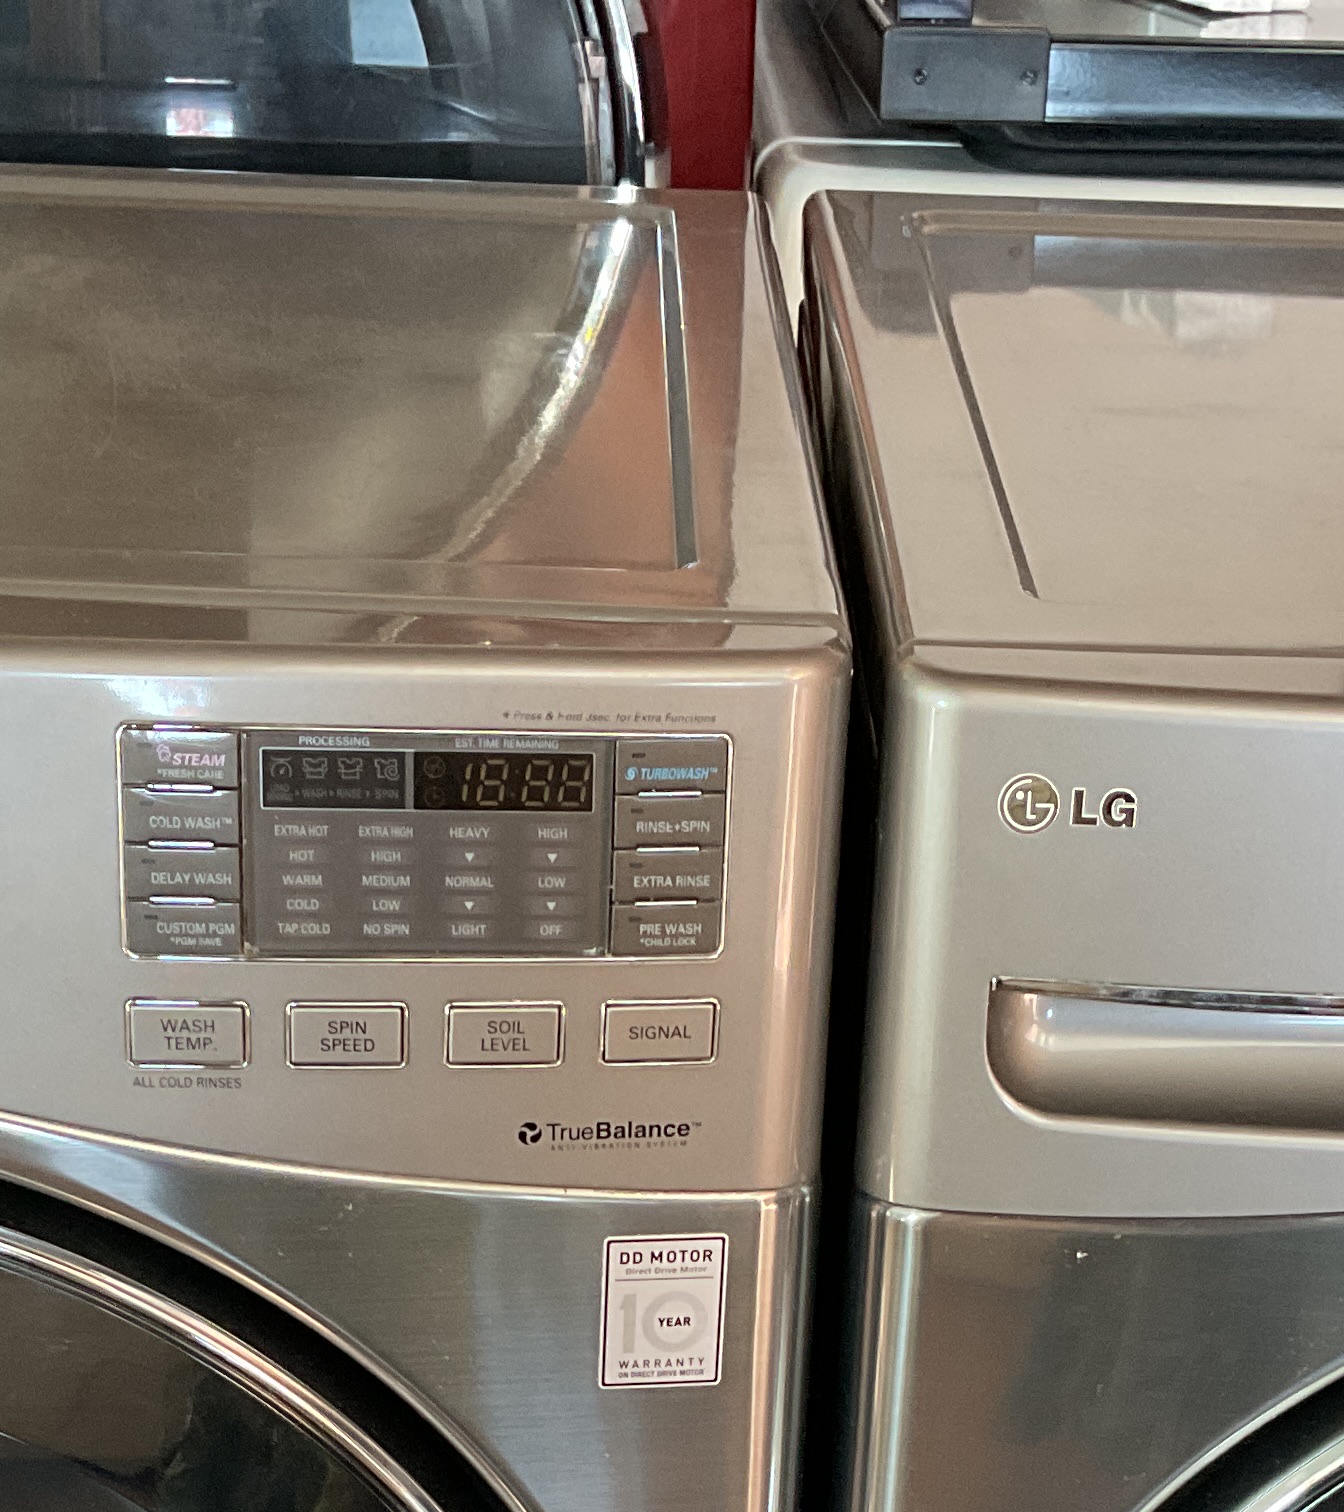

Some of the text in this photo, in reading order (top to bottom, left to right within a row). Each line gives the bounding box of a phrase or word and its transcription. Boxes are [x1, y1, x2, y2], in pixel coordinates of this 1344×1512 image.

[298, 735, 370, 747] PROCESSING
[478, 738, 501, 748] TIME
[503, 738, 559, 750] REMAINING
[172, 752, 226, 767] STEAM
[1070, 787, 1138, 828] LG
[149, 815, 181, 829] COLD
[635, 820, 711, 833] RINSE+SPIN
[274, 824, 329, 837] EXTRA HOT
[358, 825, 414, 838] EXTRA HIGH
[449, 827, 491, 839] HEAVY
[537, 827, 568, 840] HIGH
[289, 850, 315, 862] HOT
[371, 850, 402, 862] HIGH
[151, 872, 232, 885] DELAY WASH
[282, 874, 323, 886] WARM
[361, 874, 411, 887] MEDIUM
[445, 876, 495, 889] NORMAL
[537, 876, 567, 889] LOW
[633, 874, 711, 888] EXTRA RINSE
[286, 899, 320, 911] COLD
[372, 900, 401, 912] LOW
[156, 921, 236, 935] CUSTOM PGM
[277, 922, 331, 935] TAP COLD
[363, 923, 410, 936] NO SPIN
[451, 924, 486, 936] LIGHT
[539, 925, 562, 937] OFF
[639, 923, 702, 936] PRE WASH
[672, 936, 697, 947] LOCK
[160, 1018, 215, 1034] WASH
[327, 1020, 367, 1036] SPIN
[487, 1020, 525, 1036] SOIL
[628, 1025, 692, 1041] SIGNAL
[163, 1035, 218, 1052] TEMP.
[320, 1037, 376, 1053] SPEED
[480, 1037, 531, 1053] LEVEL
[132, 1076, 242, 1089] ALL COLD RINSES
[619, 1249, 714, 1265] DD MOTOR
[625, 1265, 707, 1276] Direct Drive Motor
[619, 1290, 708, 1354] 10
[657, 1316, 692, 1328] YEAR
[618, 1357, 706, 1370] WARRANTY
[618, 1371, 629, 1379] ON
[630, 1370, 655, 1378] DIRECT
[679, 1368, 705, 1377] MOTOR
